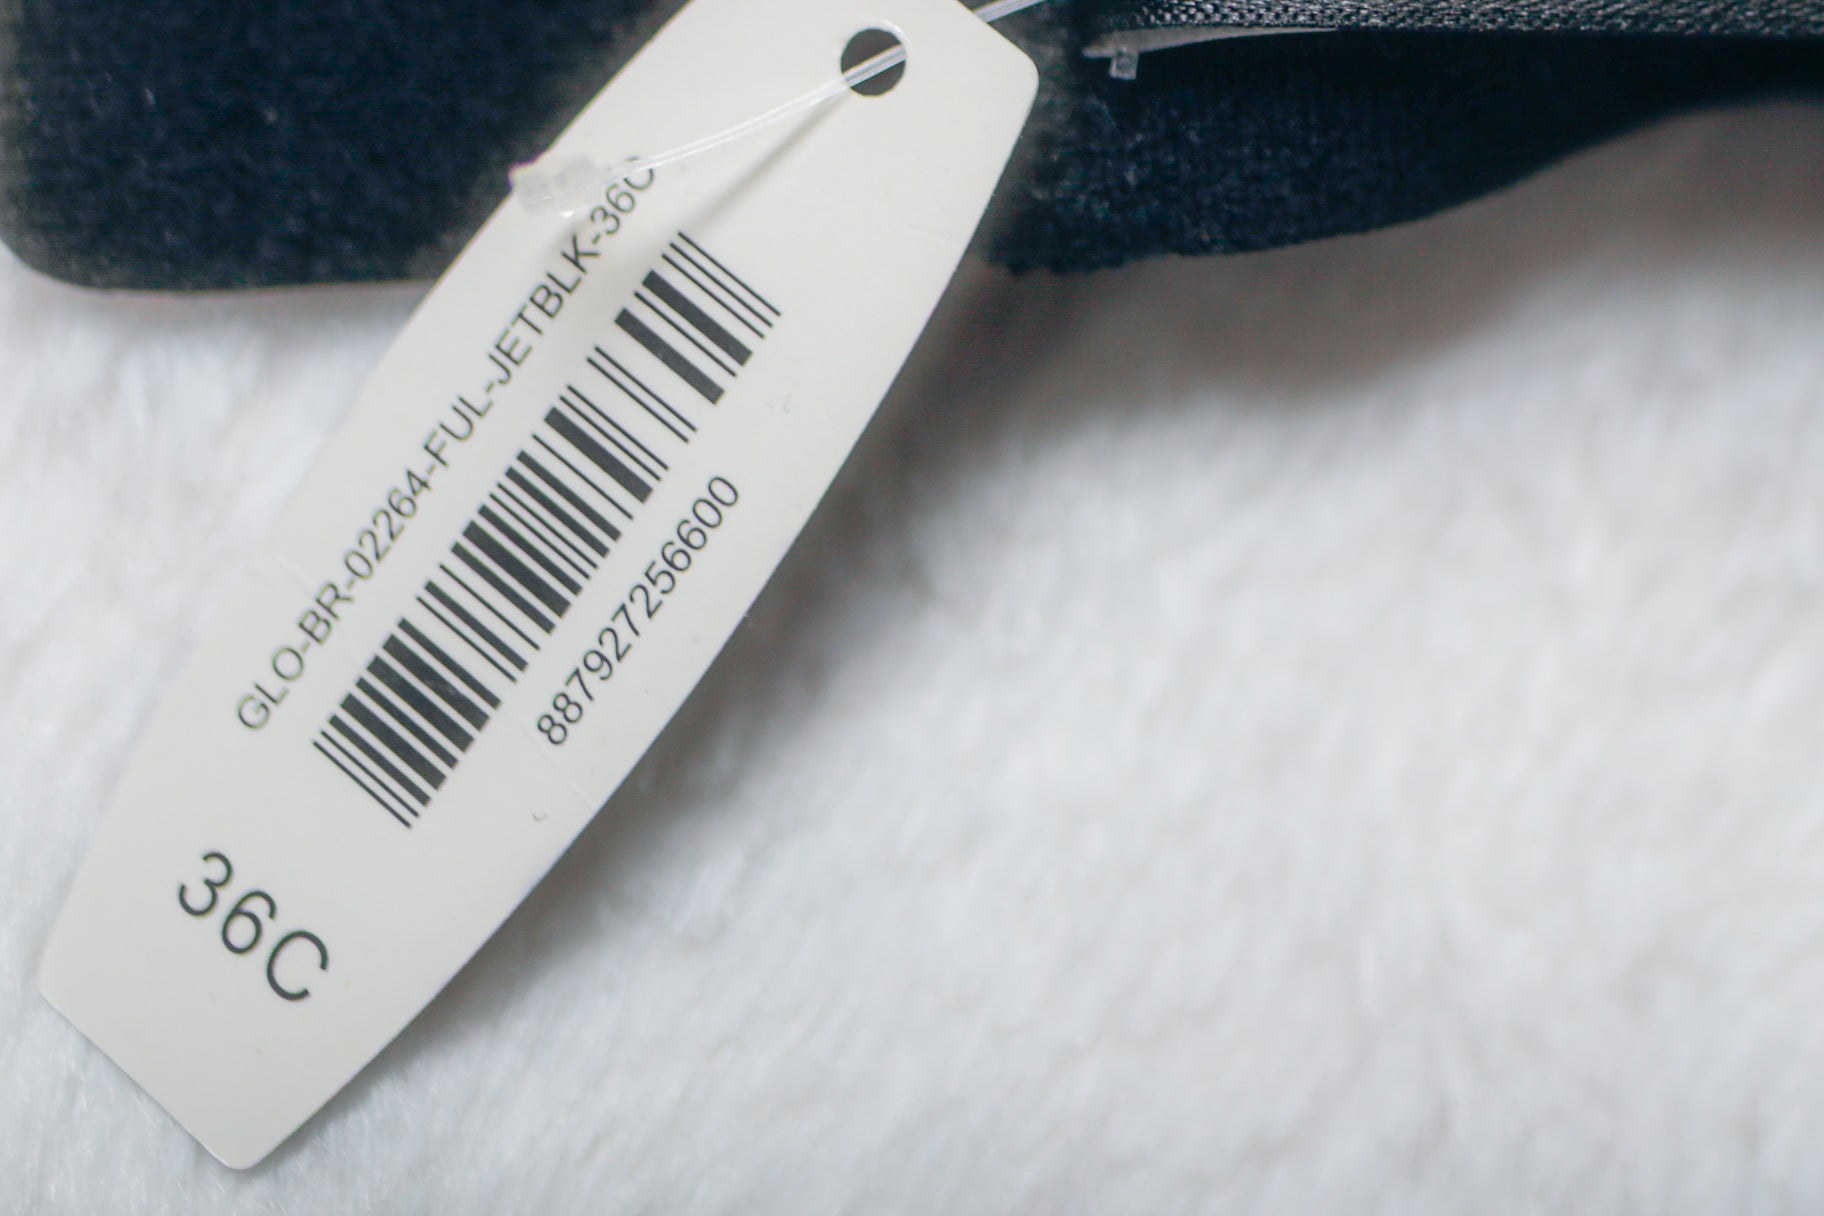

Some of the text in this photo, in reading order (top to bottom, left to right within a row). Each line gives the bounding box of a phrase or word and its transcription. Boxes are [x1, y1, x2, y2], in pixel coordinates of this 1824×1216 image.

[236, 156, 655, 732] GLO-BR-02264-FUL-JETBLK-36C
[536, 476, 739, 745] 887927256600
[178, 851, 329, 1002] 36C
